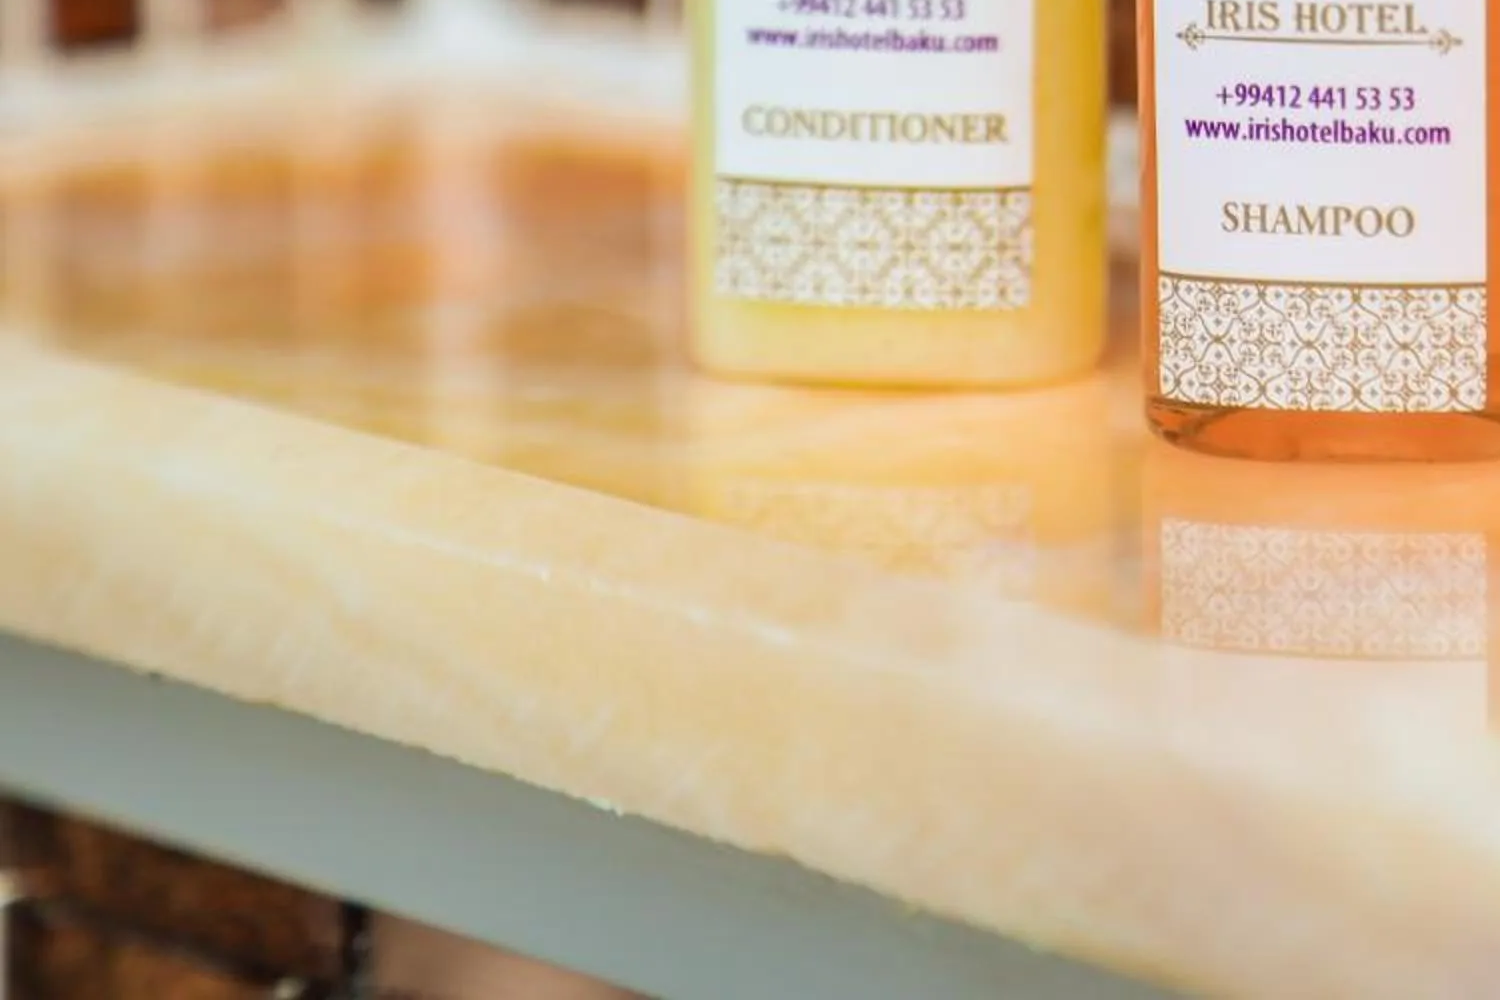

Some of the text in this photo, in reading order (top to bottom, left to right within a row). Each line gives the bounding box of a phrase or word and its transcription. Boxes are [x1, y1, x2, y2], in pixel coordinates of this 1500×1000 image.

[1205, 0, 1428, 34] IRIS HOTEL
[746, 26, 998, 54] www.irishotelbaku.com
[1216, 83, 1415, 112] +99412 441 53 53
[741, 105, 1009, 144] CONDITIONER
[1184, 116, 1451, 145] www.irishotelbaku.com
[1220, 201, 1416, 237] SHAMPOO
